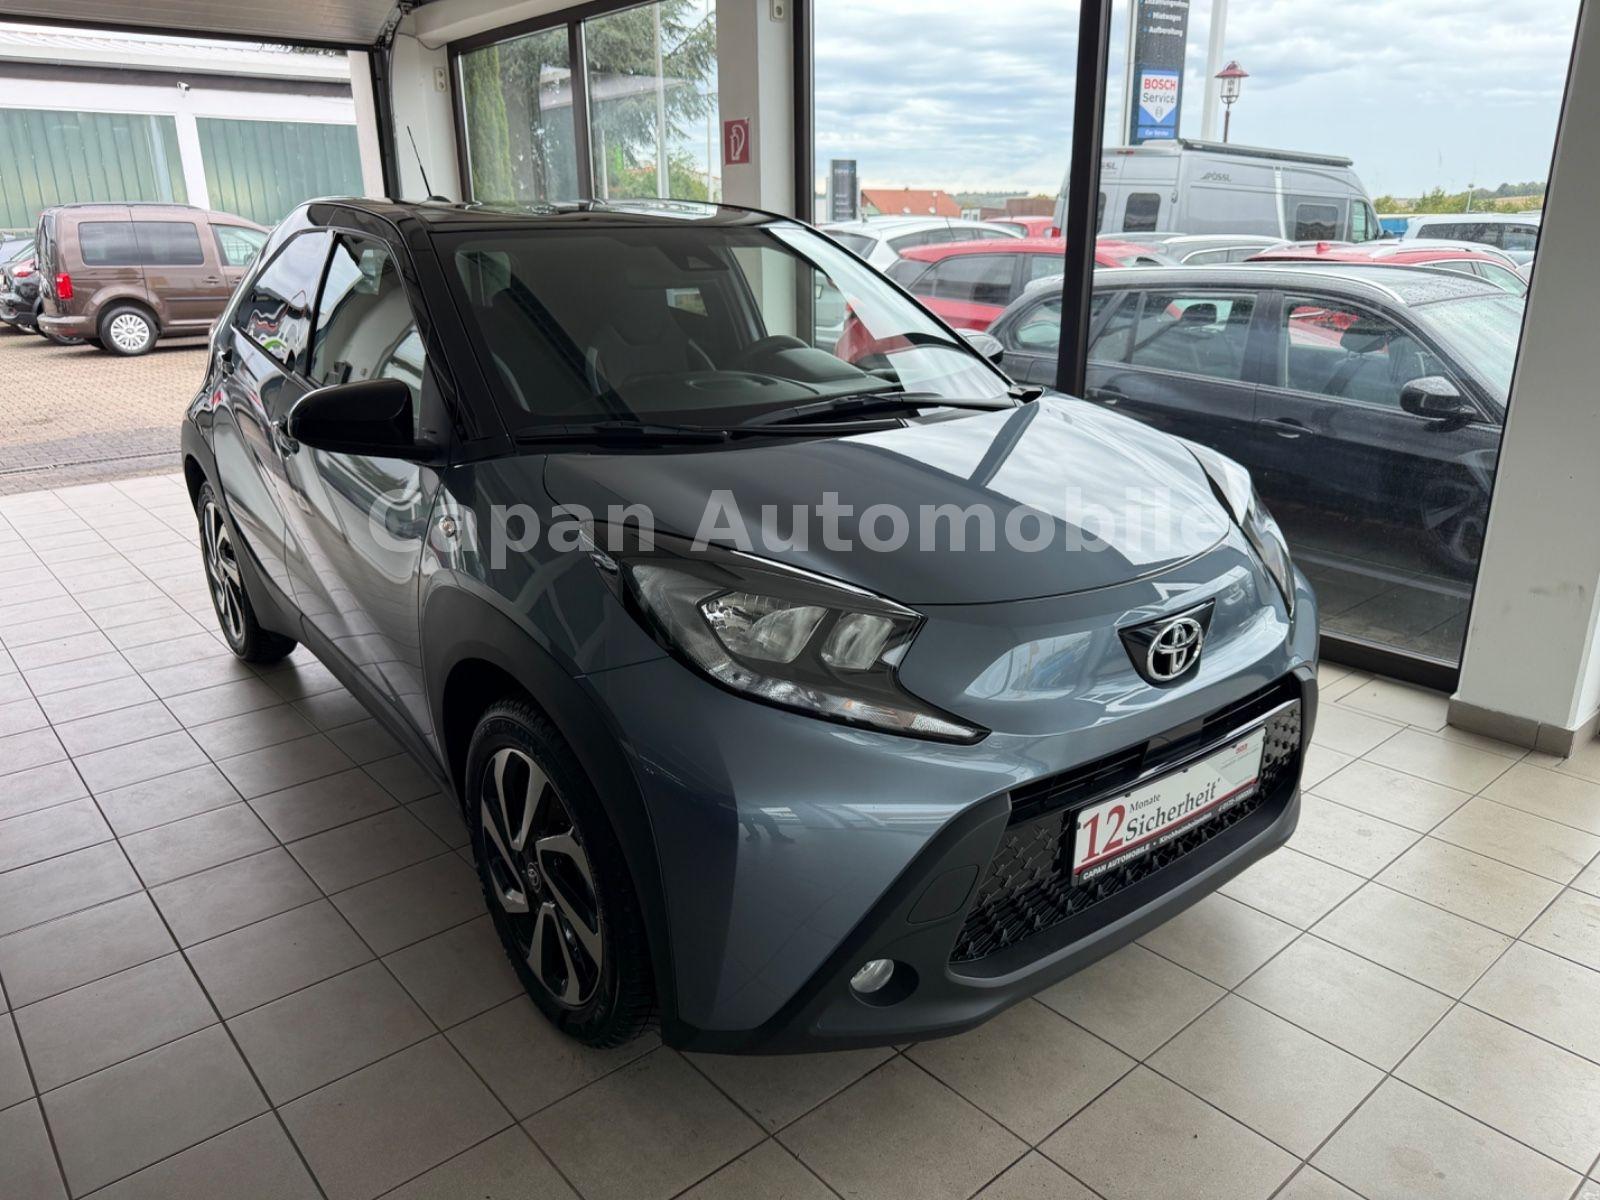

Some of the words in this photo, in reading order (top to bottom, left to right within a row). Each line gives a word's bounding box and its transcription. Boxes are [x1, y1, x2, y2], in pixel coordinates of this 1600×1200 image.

[1143, 78, 1176, 92] BOSCH
[1142, 92, 1175, 104] Service
[1129, 793, 1161, 813] Monate
[1081, 804, 1126, 863] 12
[1082, 864, 1108, 881] CAPAN
[1106, 843, 1151, 869] AUTOMOBILE
